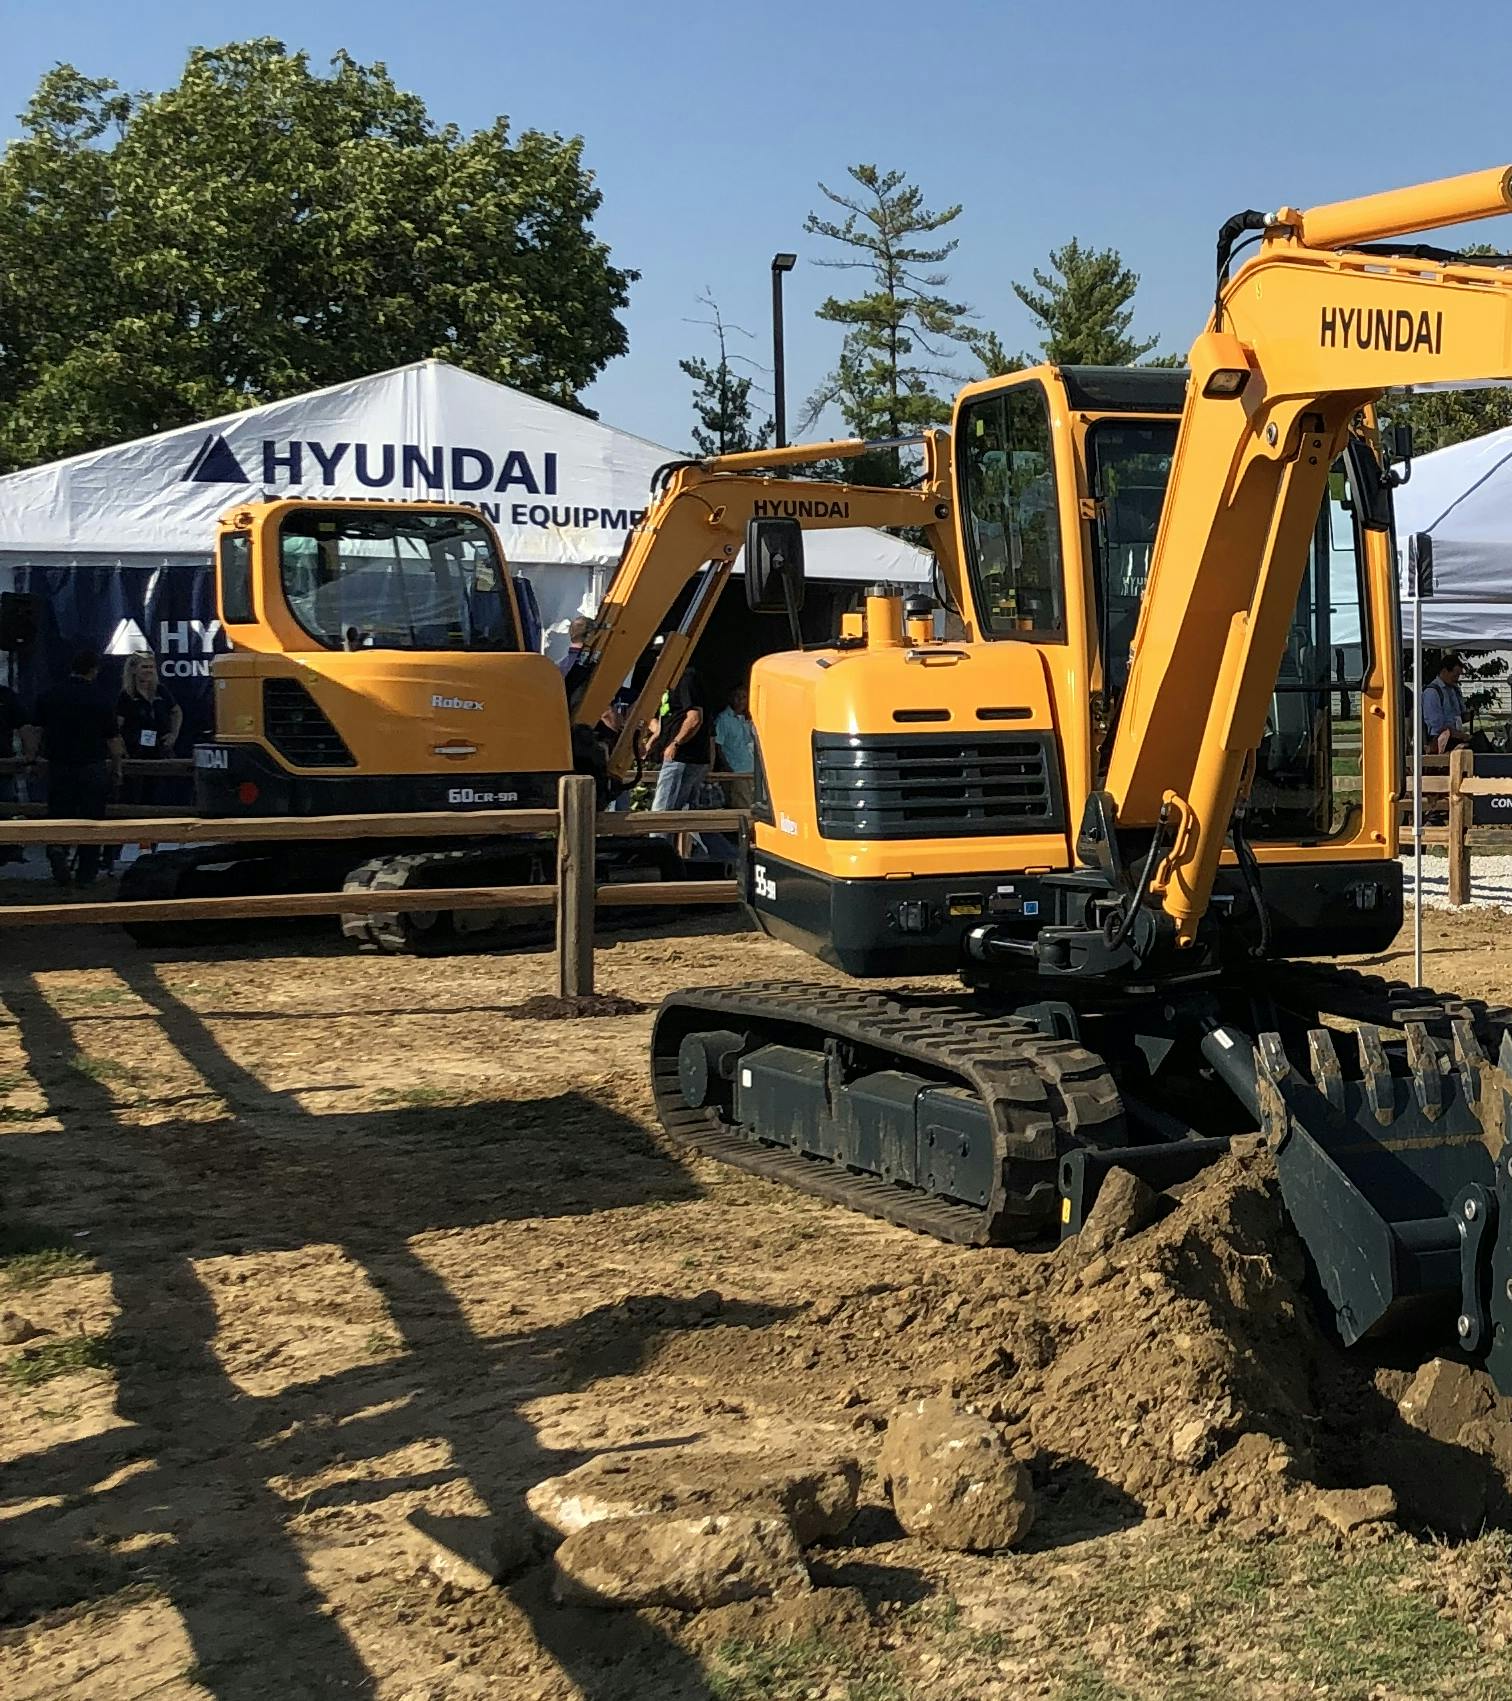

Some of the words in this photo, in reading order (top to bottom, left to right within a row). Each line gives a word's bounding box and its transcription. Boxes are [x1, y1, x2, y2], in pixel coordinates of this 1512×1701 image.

[1321, 307, 1442, 354] HYUNDAI
[263, 440, 557, 495] HYUNDAI
[754, 499, 849, 518] HYUNDAI
[432, 695, 484, 711] Robex
